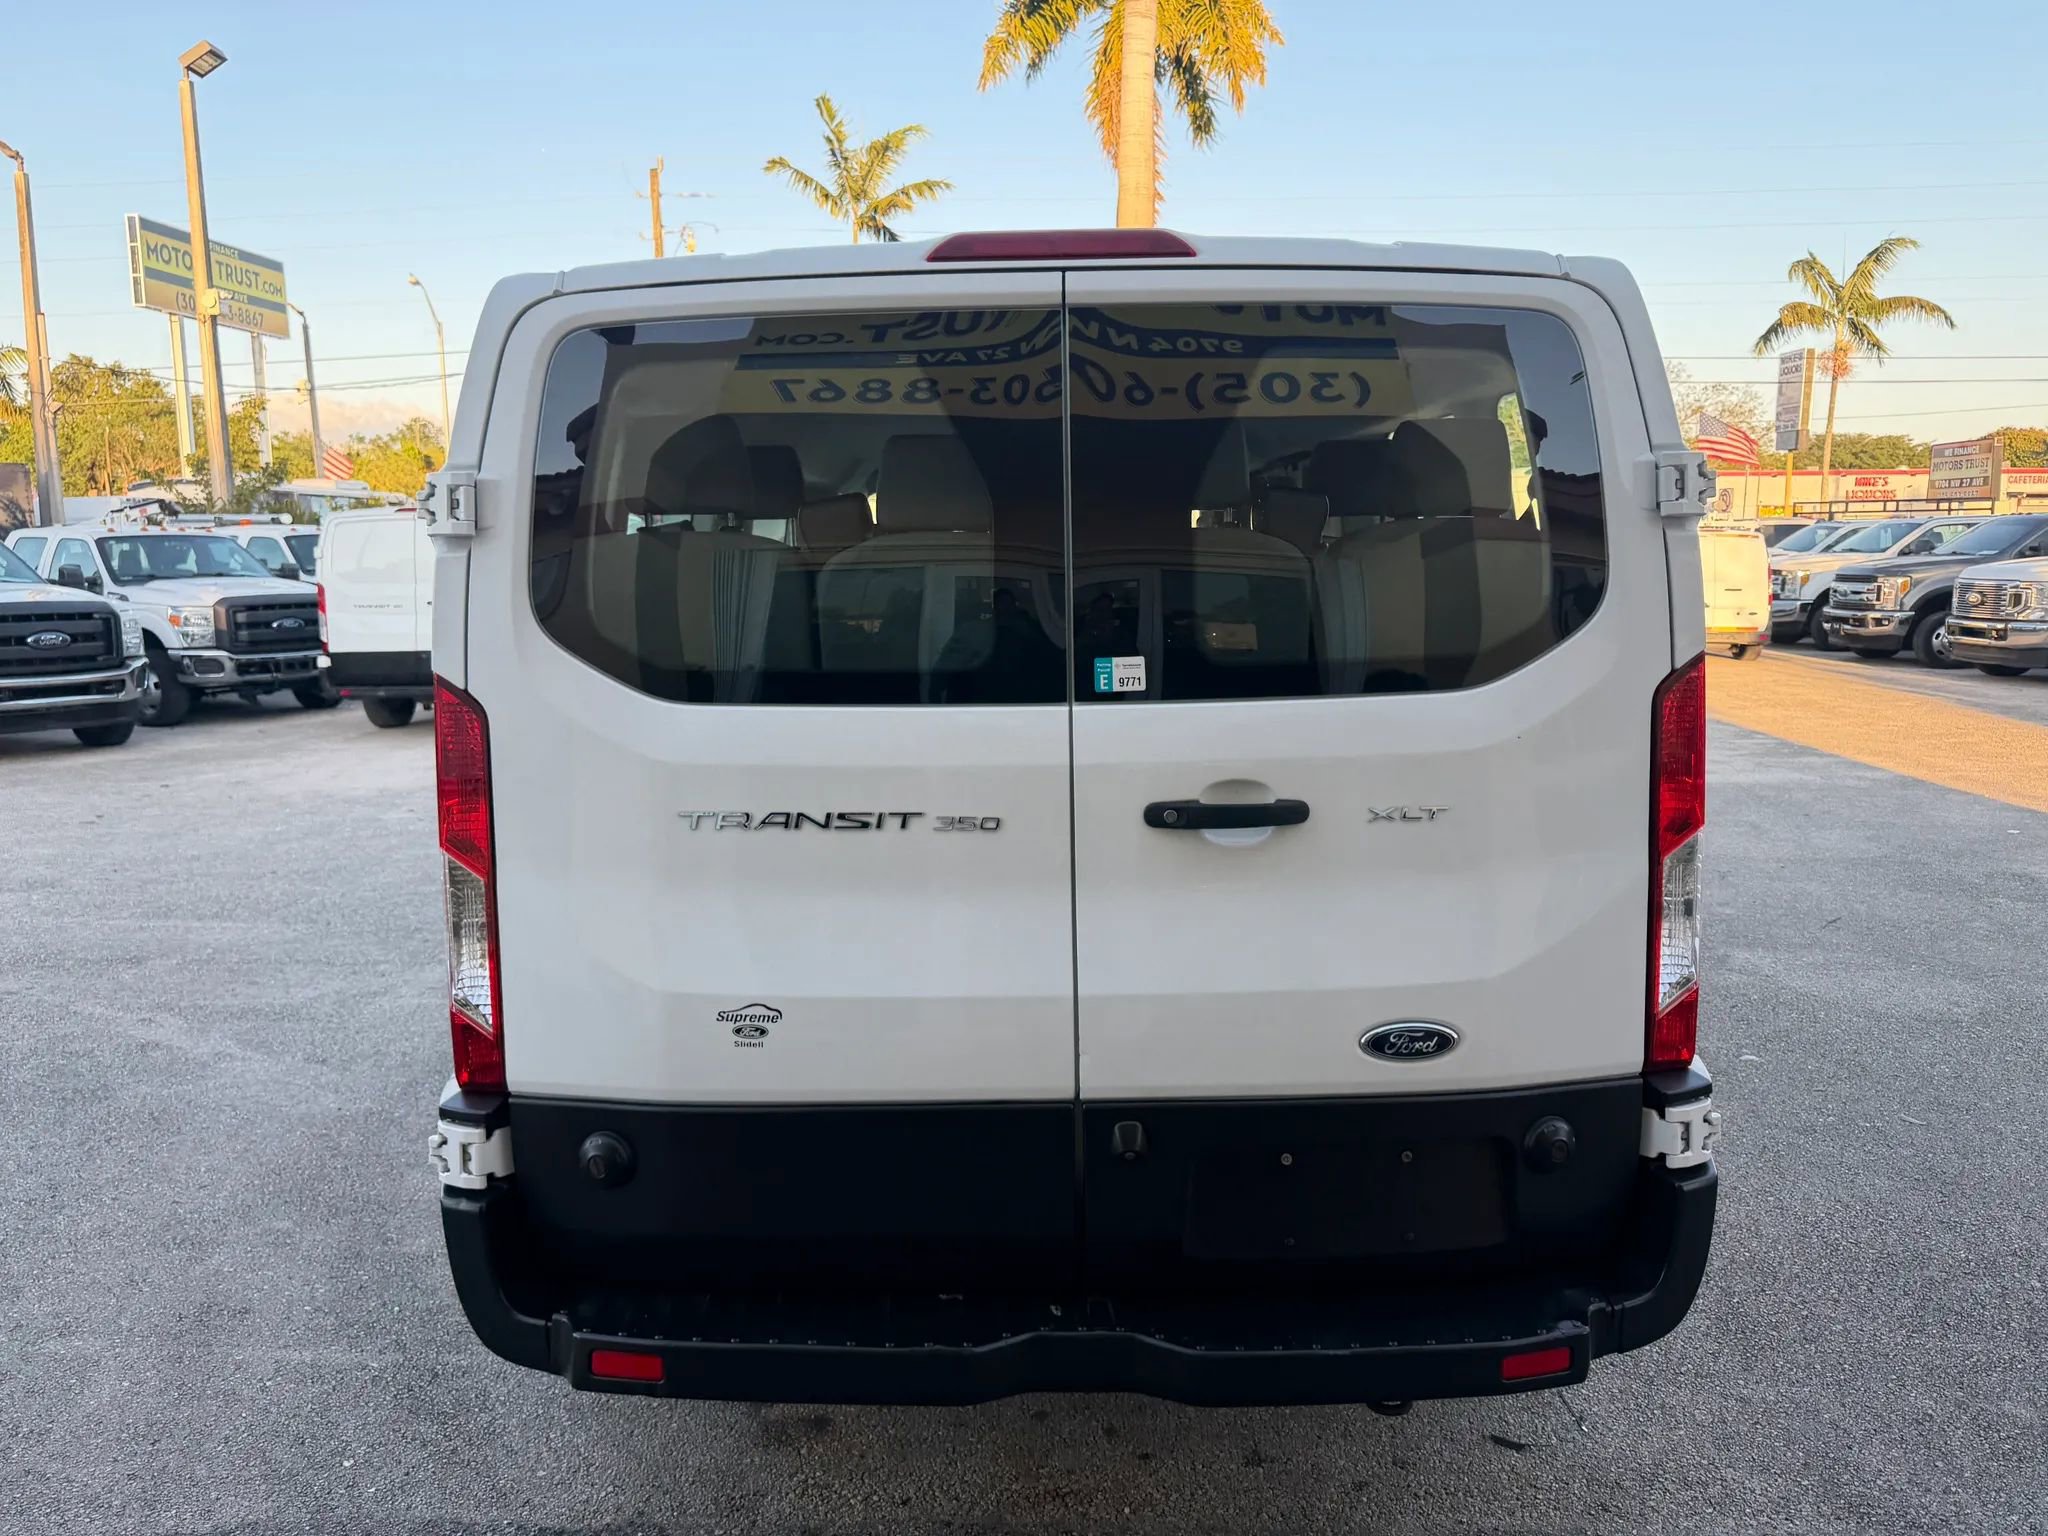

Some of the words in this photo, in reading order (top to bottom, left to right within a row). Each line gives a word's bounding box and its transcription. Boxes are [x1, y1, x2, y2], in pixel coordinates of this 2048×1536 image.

[145, 239, 194, 270] MOTO
[215, 260, 284, 298] TRUST.COM
[1932, 460, 1963, 472] MOTORS
[1965, 457, 1990, 469] TRUST
[1972, 477, 1985, 486] AVE
[1100, 674, 1109, 690] E
[1118, 675, 1142, 688] 9771
[1367, 805, 1450, 823] XLT
[678, 811, 926, 832] TRANSIT
[932, 815, 1002, 833] 350
[716, 1010, 780, 1024] Supreme
[734, 1040, 764, 1048] Slidell
[1384, 1031, 1439, 1054] Ford
